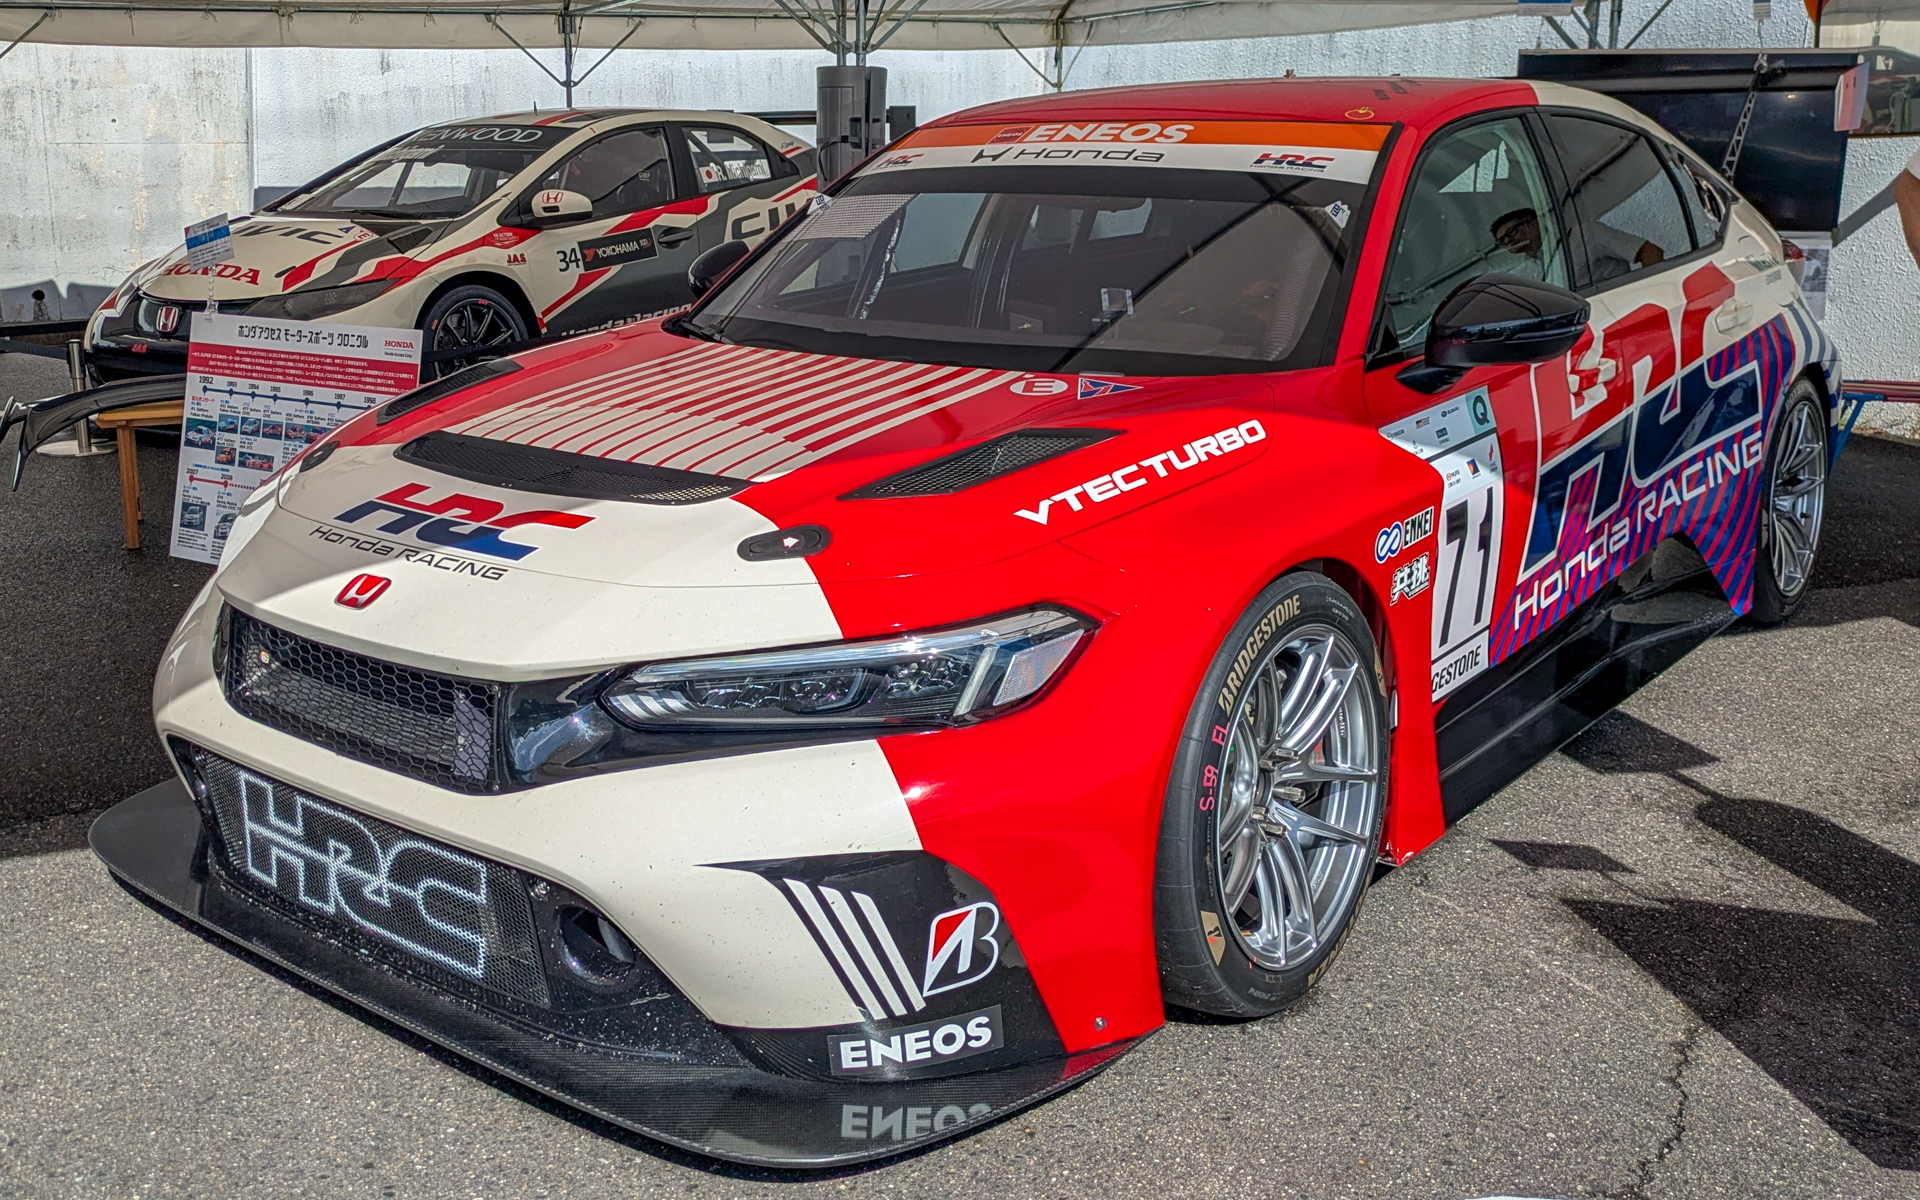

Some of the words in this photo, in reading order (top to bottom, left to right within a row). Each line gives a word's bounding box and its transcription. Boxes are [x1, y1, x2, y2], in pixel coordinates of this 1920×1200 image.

[1024, 122, 1195, 143] ENEOS
[1012, 147, 1165, 164] Honda
[1252, 153, 1336, 170] HRC
[727, 160, 765, 181] Michigami
[556, 248, 581, 273] 34
[595, 240, 640, 259] YOKOHAMA
[238, 324, 282, 342] ホンダアクセス
[283, 327, 335, 345] モータースポーツ
[336, 332, 369, 349] クロニクル
[384, 340, 415, 349] HONDA
[198, 375, 214, 385] 1992
[226, 380, 238, 389] 1993
[248, 383, 260, 391] 1994
[1472, 394, 1491, 426] Q
[186, 467, 199, 476] 2007
[220, 473, 234, 481] 2008
[1013, 463, 1148, 526] VTEC
[1138, 419, 1267, 479] TURBO
[332, 482, 599, 562] HRC
[1403, 508, 1434, 547] ENKEI
[1515, 516, 1630, 631] Honda
[1636, 430, 1763, 533] RACING
[309, 526, 395, 557] Honda
[394, 549, 510, 581] RACING
[1438, 486, 1494, 649] 71
[1217, 594, 1301, 717] BRIDGESTONE
[238, 770, 487, 979] HRC
[839, 1016, 993, 1069] ENEOS
